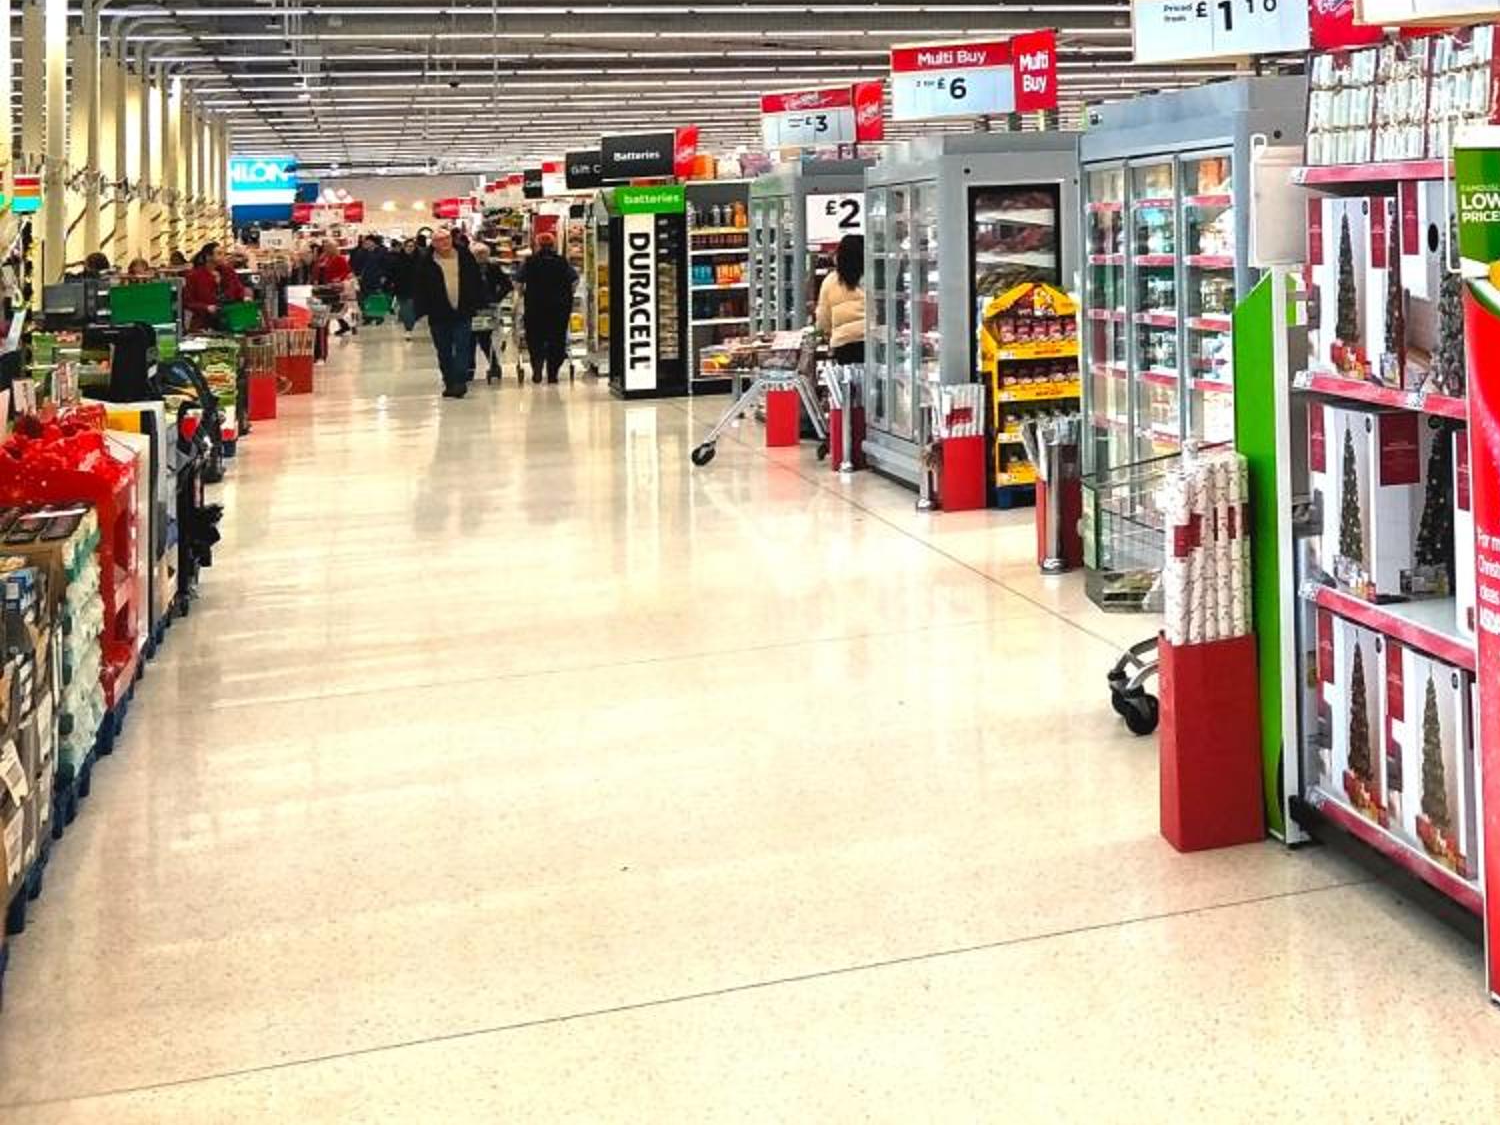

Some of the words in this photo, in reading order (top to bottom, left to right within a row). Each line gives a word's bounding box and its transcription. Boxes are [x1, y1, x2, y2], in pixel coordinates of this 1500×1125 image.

[917, 50, 954, 66] Multi
[957, 49, 987, 64] Buy
[1019, 50, 1049, 72] Multi
[1022, 74, 1048, 94] Buy
[613, 150, 661, 162] Batteries
[623, 194, 681, 204] batteries
[628, 231, 651, 370] DURACELL
